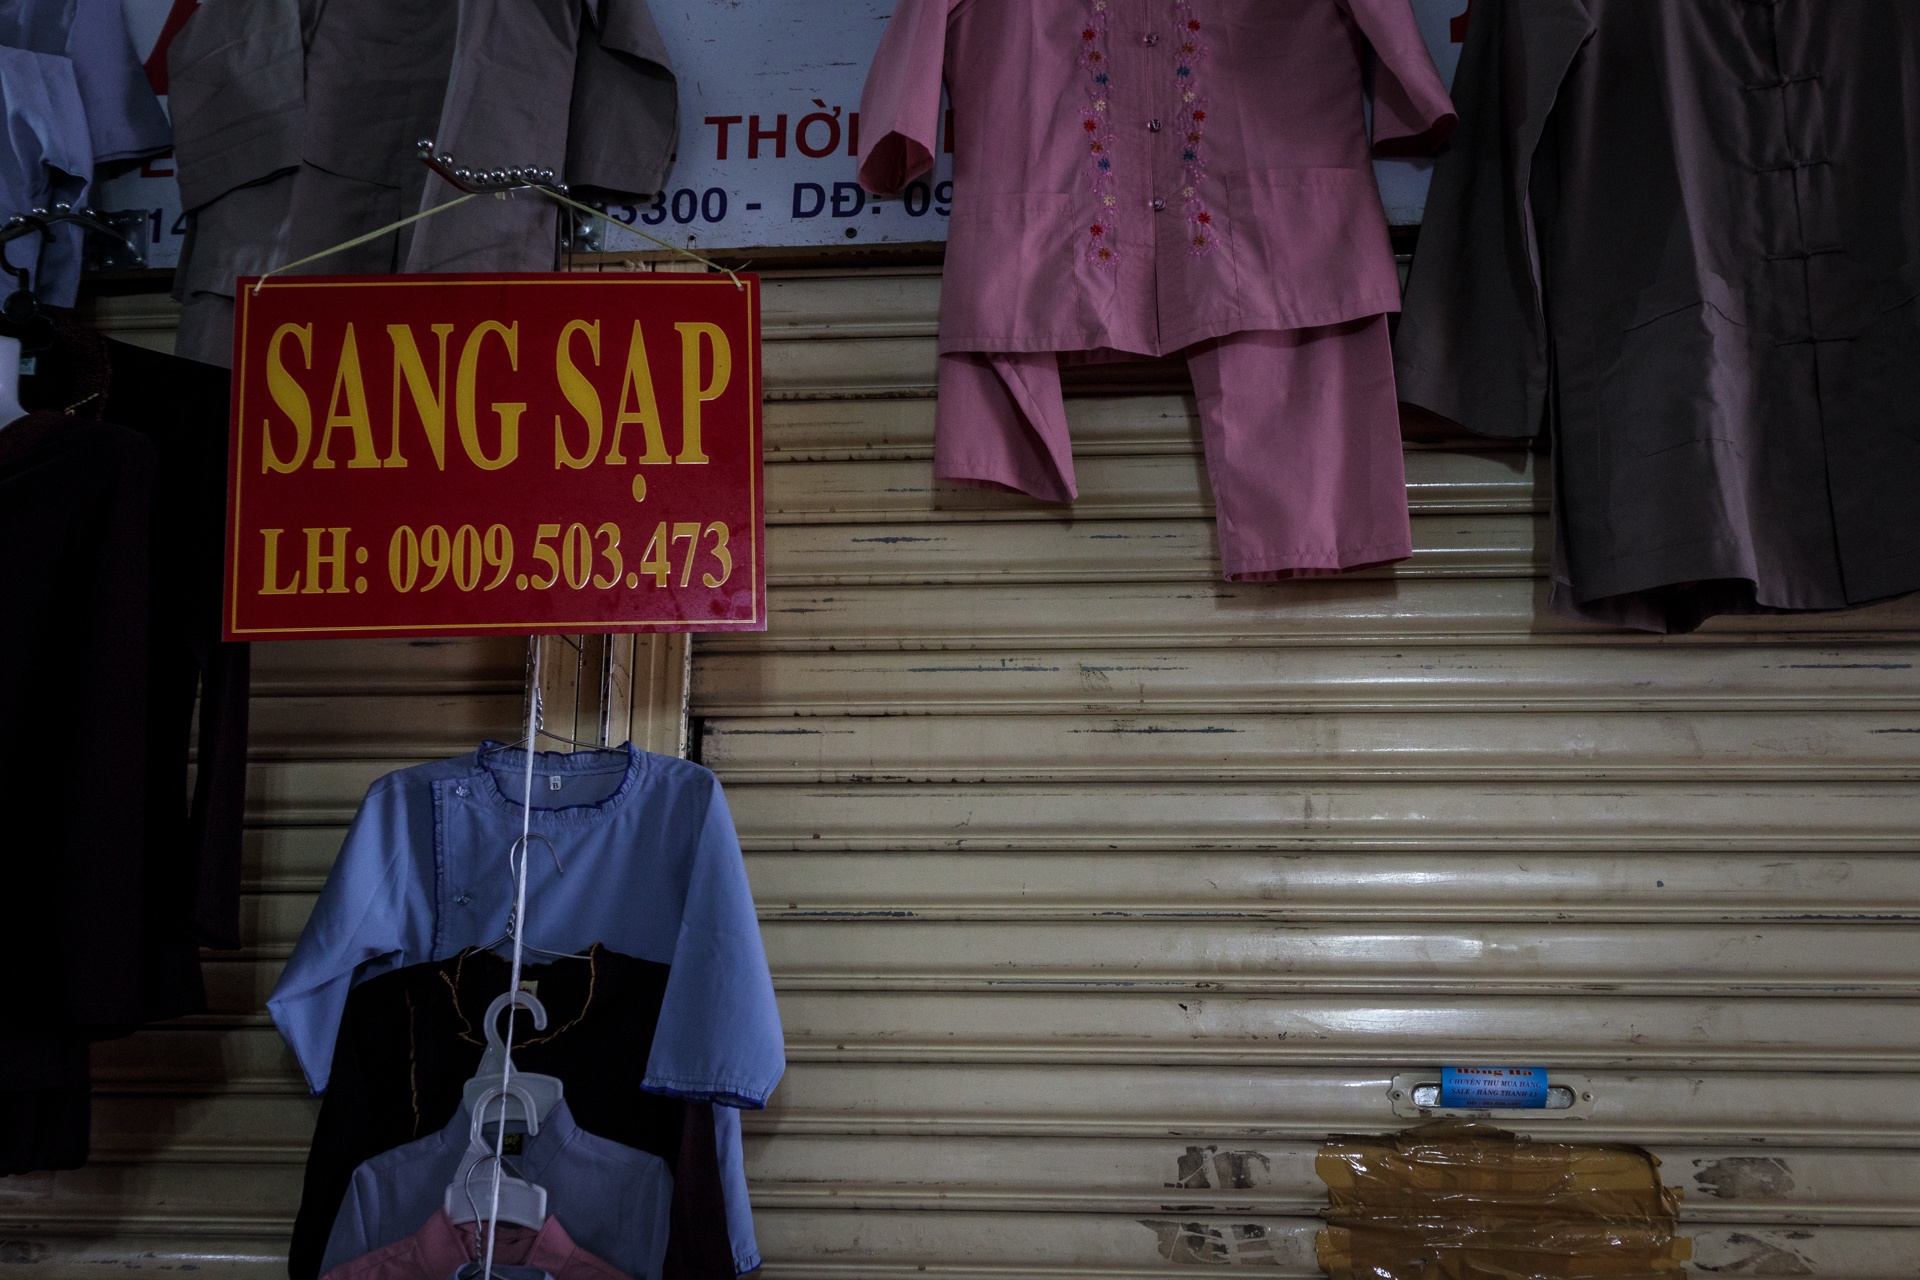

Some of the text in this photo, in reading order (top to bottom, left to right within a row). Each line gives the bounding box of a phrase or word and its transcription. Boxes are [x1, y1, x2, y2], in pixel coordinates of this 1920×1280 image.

[261, 318, 732, 503] SANG SẠP
[257, 520, 733, 596] LH: 0909.503.473
[1483, 1079, 1499, 1087] THU
